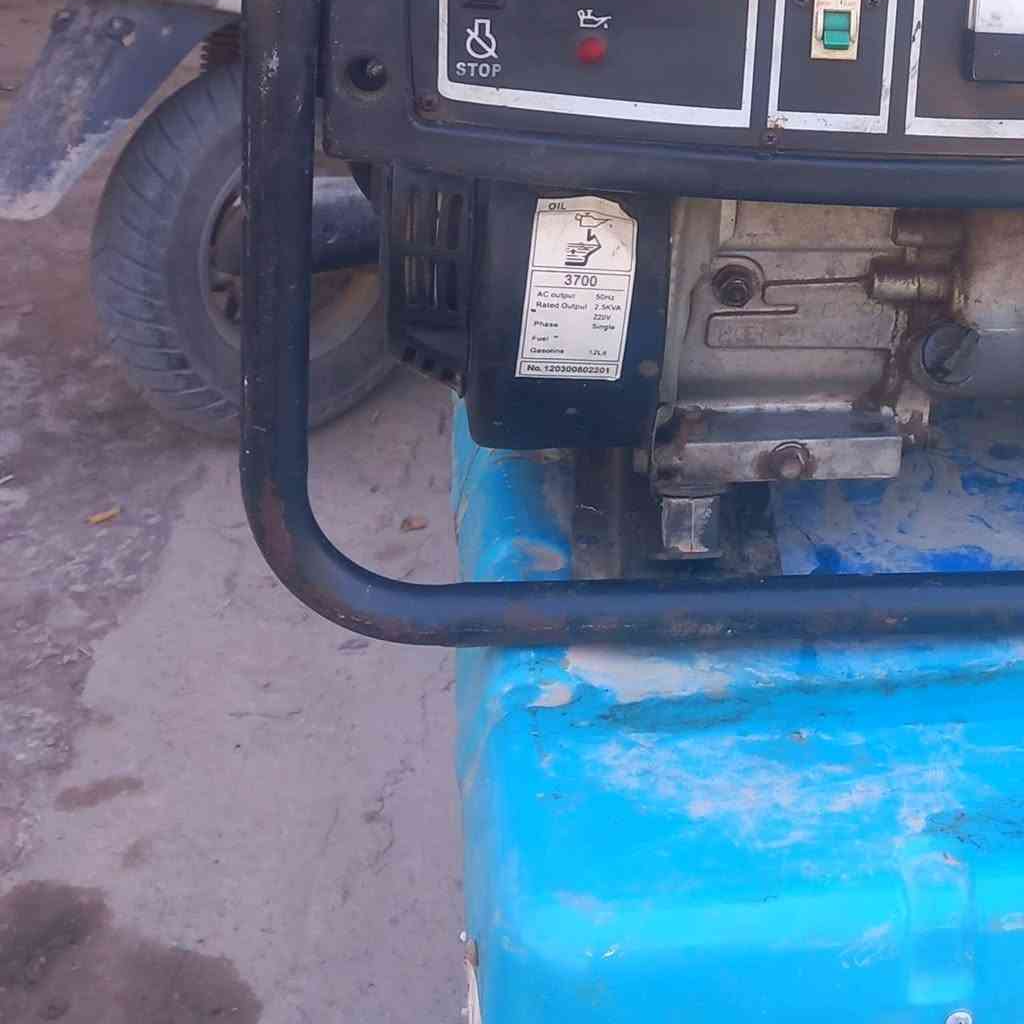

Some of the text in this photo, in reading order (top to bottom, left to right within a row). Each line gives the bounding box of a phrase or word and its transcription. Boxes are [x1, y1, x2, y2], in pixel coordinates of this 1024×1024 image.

[455, 62, 501, 77] STOP
[548, 202, 567, 211] OIL
[564, 274, 598, 287] 3700
[535, 301, 559, 309] Rated
[561, 302, 588, 311] Output
[533, 320, 559, 328] Phase
